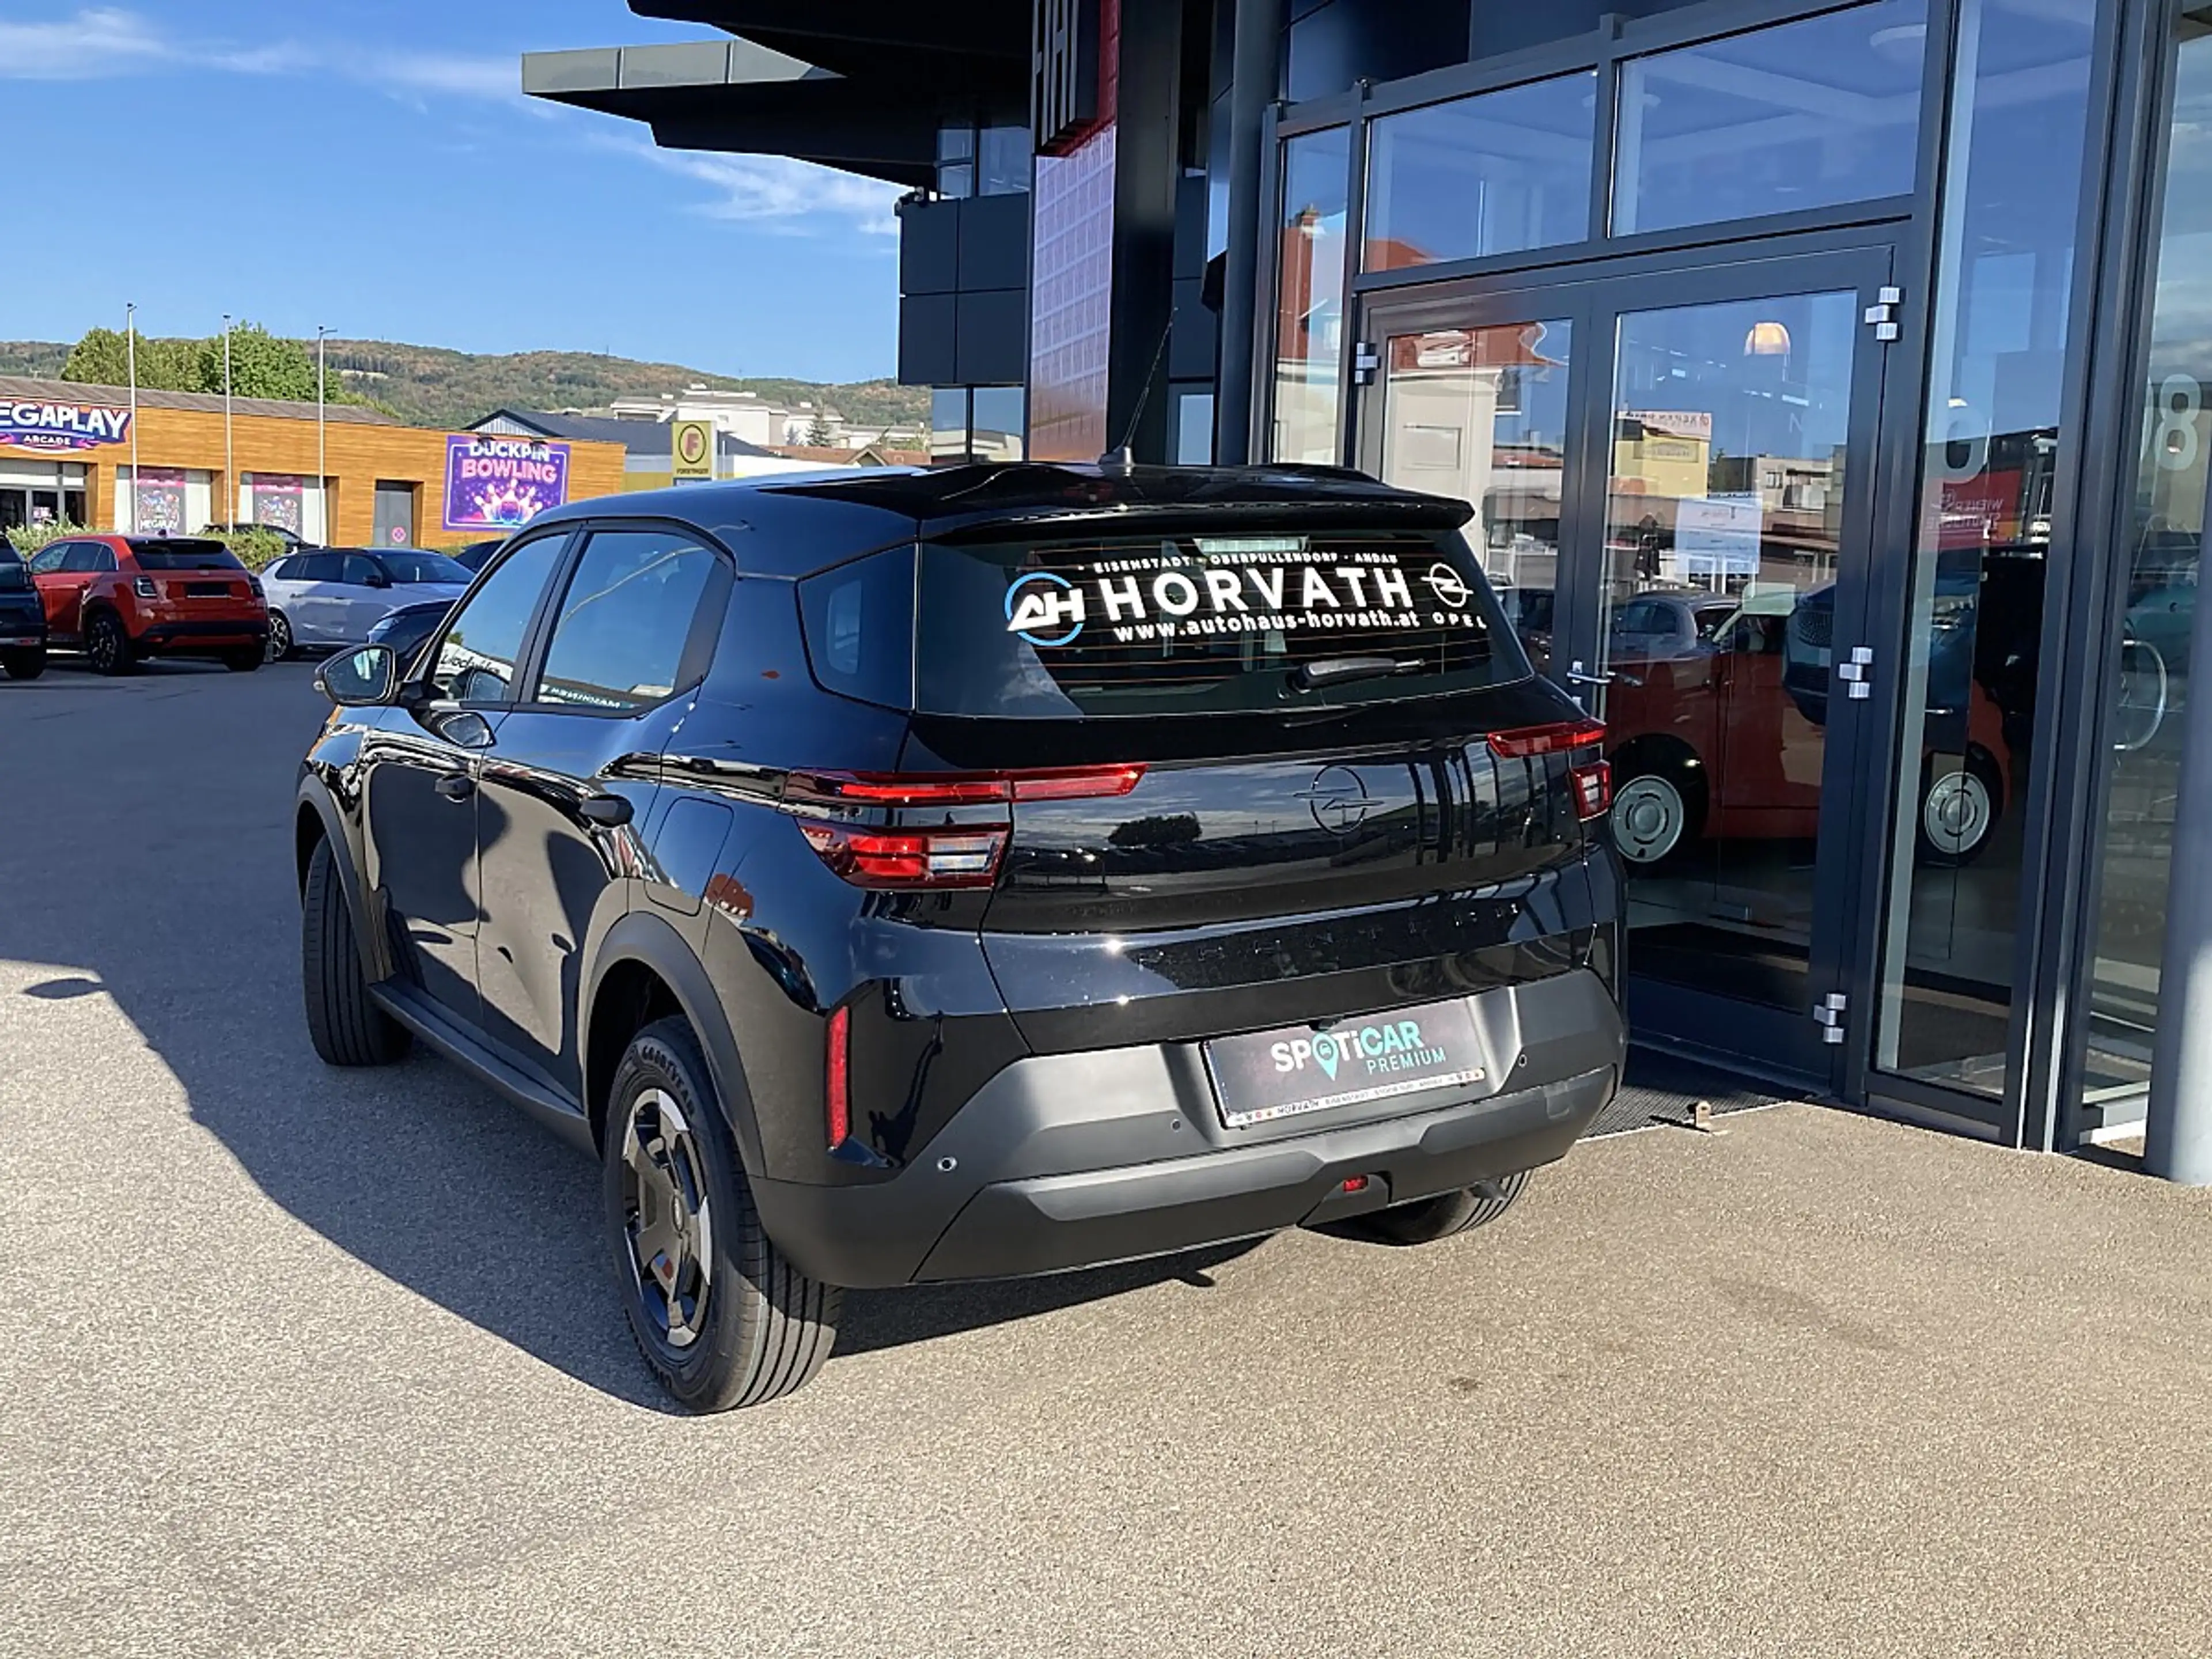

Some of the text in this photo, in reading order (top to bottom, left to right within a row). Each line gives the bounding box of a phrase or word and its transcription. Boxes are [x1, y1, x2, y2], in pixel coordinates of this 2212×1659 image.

[24, 435, 71, 445] ARCADE
[469, 440, 551, 462] DUCKPIN
[685, 433, 699, 457] F
[462, 459, 557, 484] BOWLING
[1093, 552, 1398, 574] EISENSTADT OBERPULLENDORF ANDAU
[1007, 566, 1414, 631] AH HORVATH
[1113, 609, 1420, 642] www.autohaus-horvath.at
[1432, 611, 1487, 629] OPEL
[1366, 1047, 1446, 1075] PREMIUM
